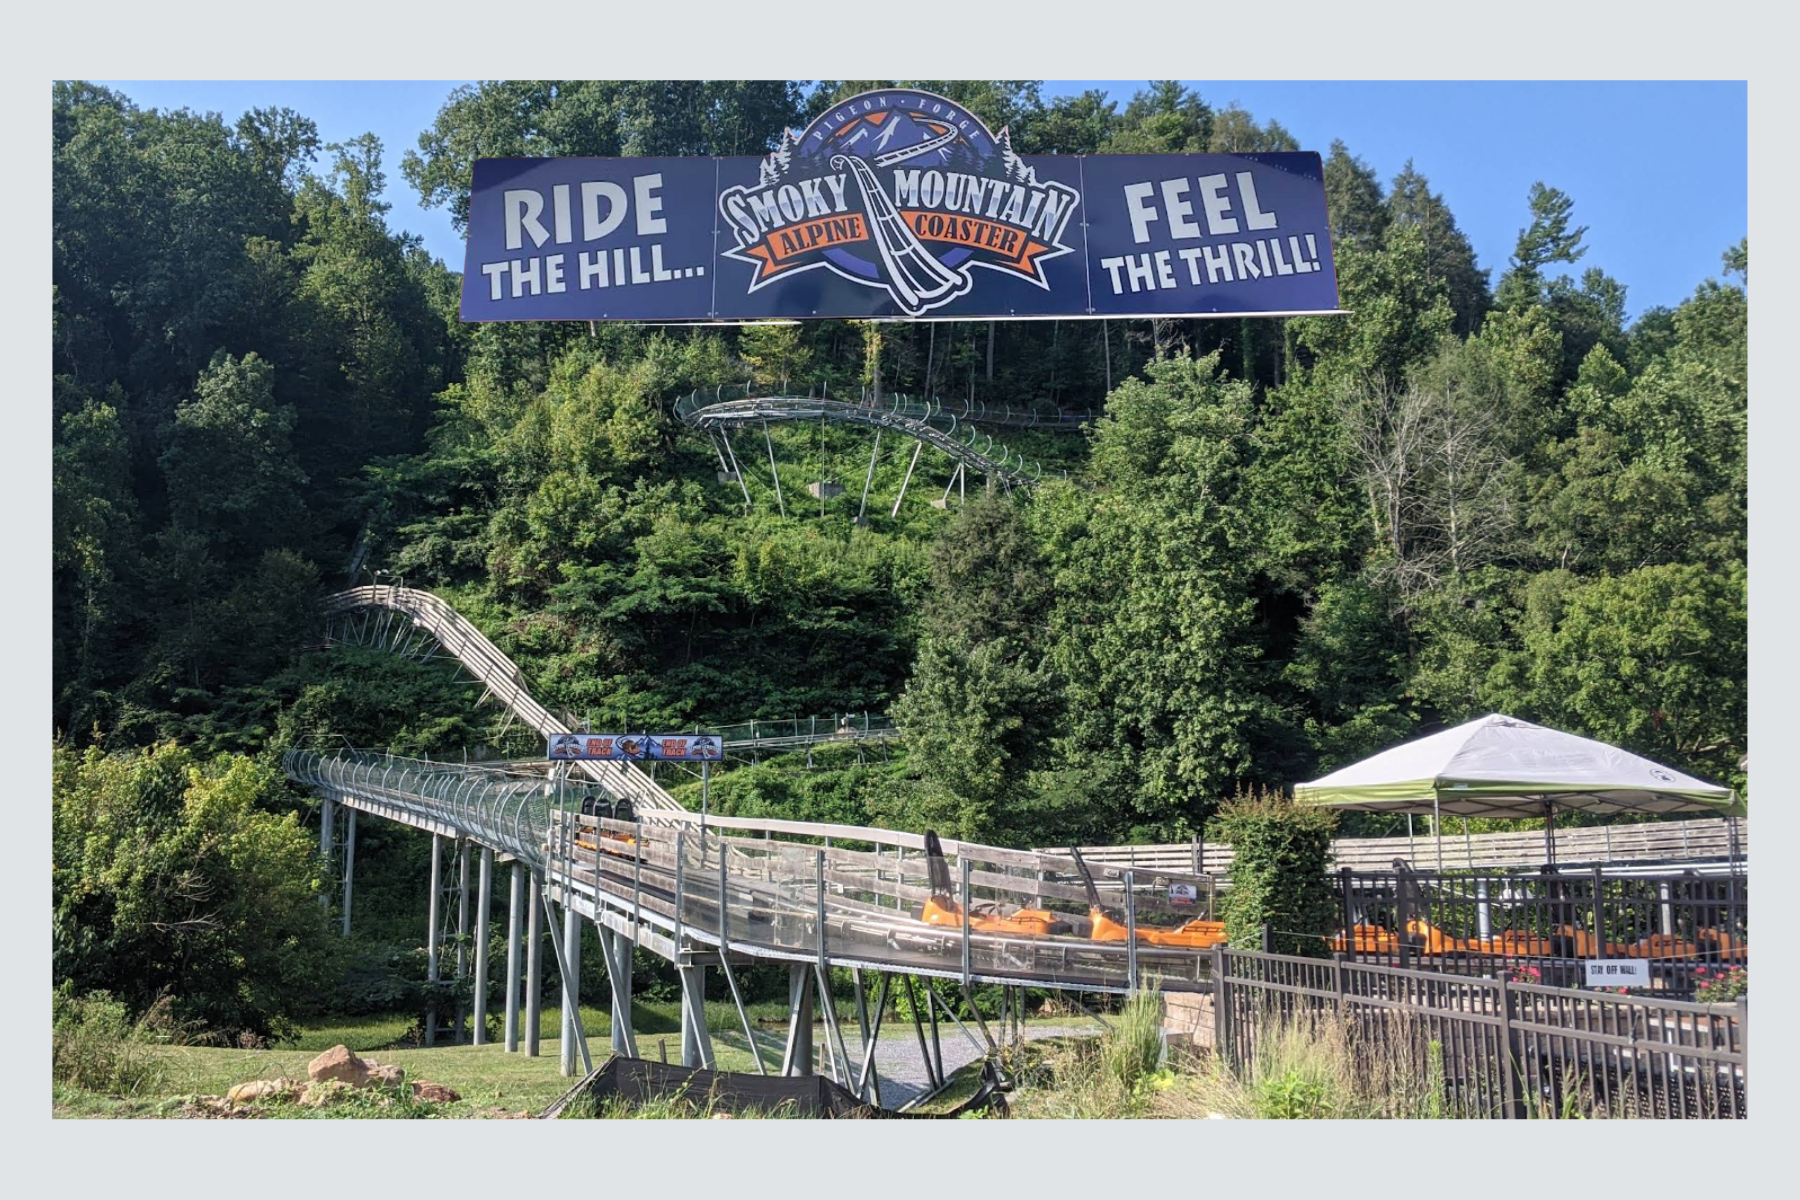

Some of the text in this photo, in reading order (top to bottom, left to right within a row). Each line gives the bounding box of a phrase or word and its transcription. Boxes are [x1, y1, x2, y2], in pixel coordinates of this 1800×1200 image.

[812, 96, 980, 141] PIGEON FORGE
[504, 172, 668, 250] RIDE
[726, 169, 1071, 245] SMOKY MOUNTAIN
[1123, 170, 1278, 245] FEEL
[779, 213, 1019, 255] ALPINE COASTER
[482, 244, 705, 300] THE HILL...
[1101, 233, 1321, 296] THE THRILL!
[586, 737, 614, 747] END OF
[587, 746, 613, 756] TRACK
[662, 738, 688, 747] END OF
[662, 747, 687, 756] TRACK
[1590, 965, 1604, 975] STAY
[1606, 965, 1618, 975] OFF
